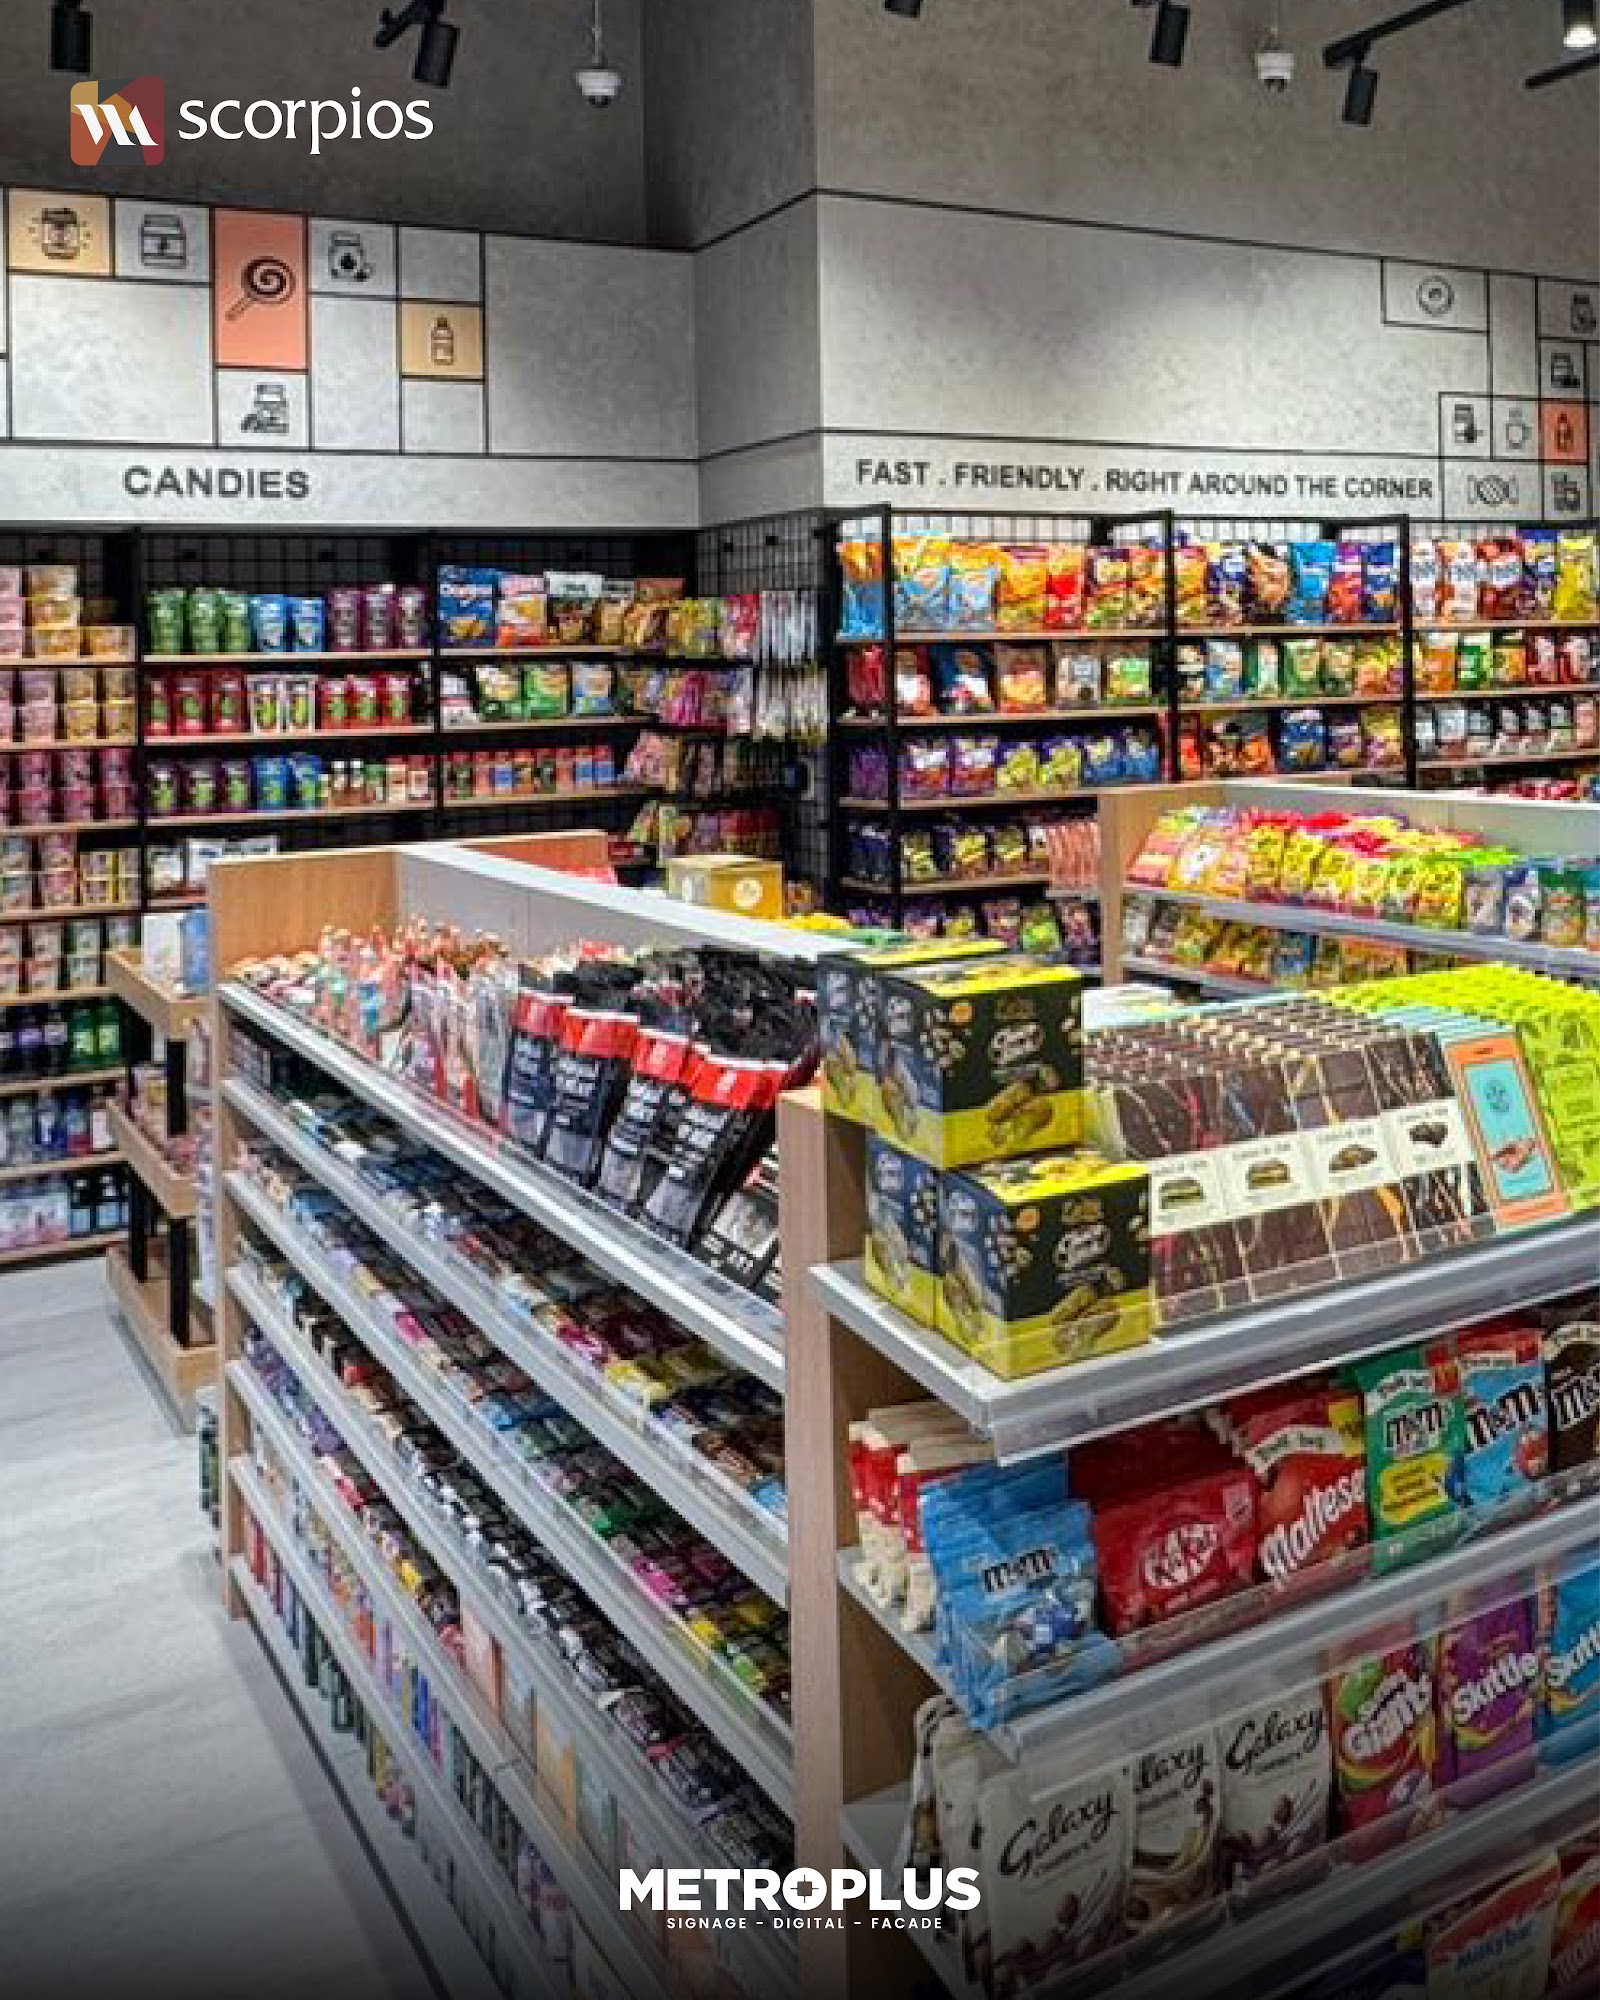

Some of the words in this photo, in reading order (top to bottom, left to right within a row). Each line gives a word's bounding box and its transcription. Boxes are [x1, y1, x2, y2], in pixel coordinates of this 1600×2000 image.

[123, 466, 310, 499] CANDIES
[856, 458, 931, 486] FAST
[954, 461, 1086, 492] FRIENDLY
[1105, 468, 1184, 492] RIGHT
[1189, 473, 1288, 495] AROUND
[1294, 475, 1338, 498] THE
[1343, 477, 1434, 500] CORNER
[1225, 1707, 1325, 1776] Galaxy
[999, 1792, 1118, 1880] Galaxy
